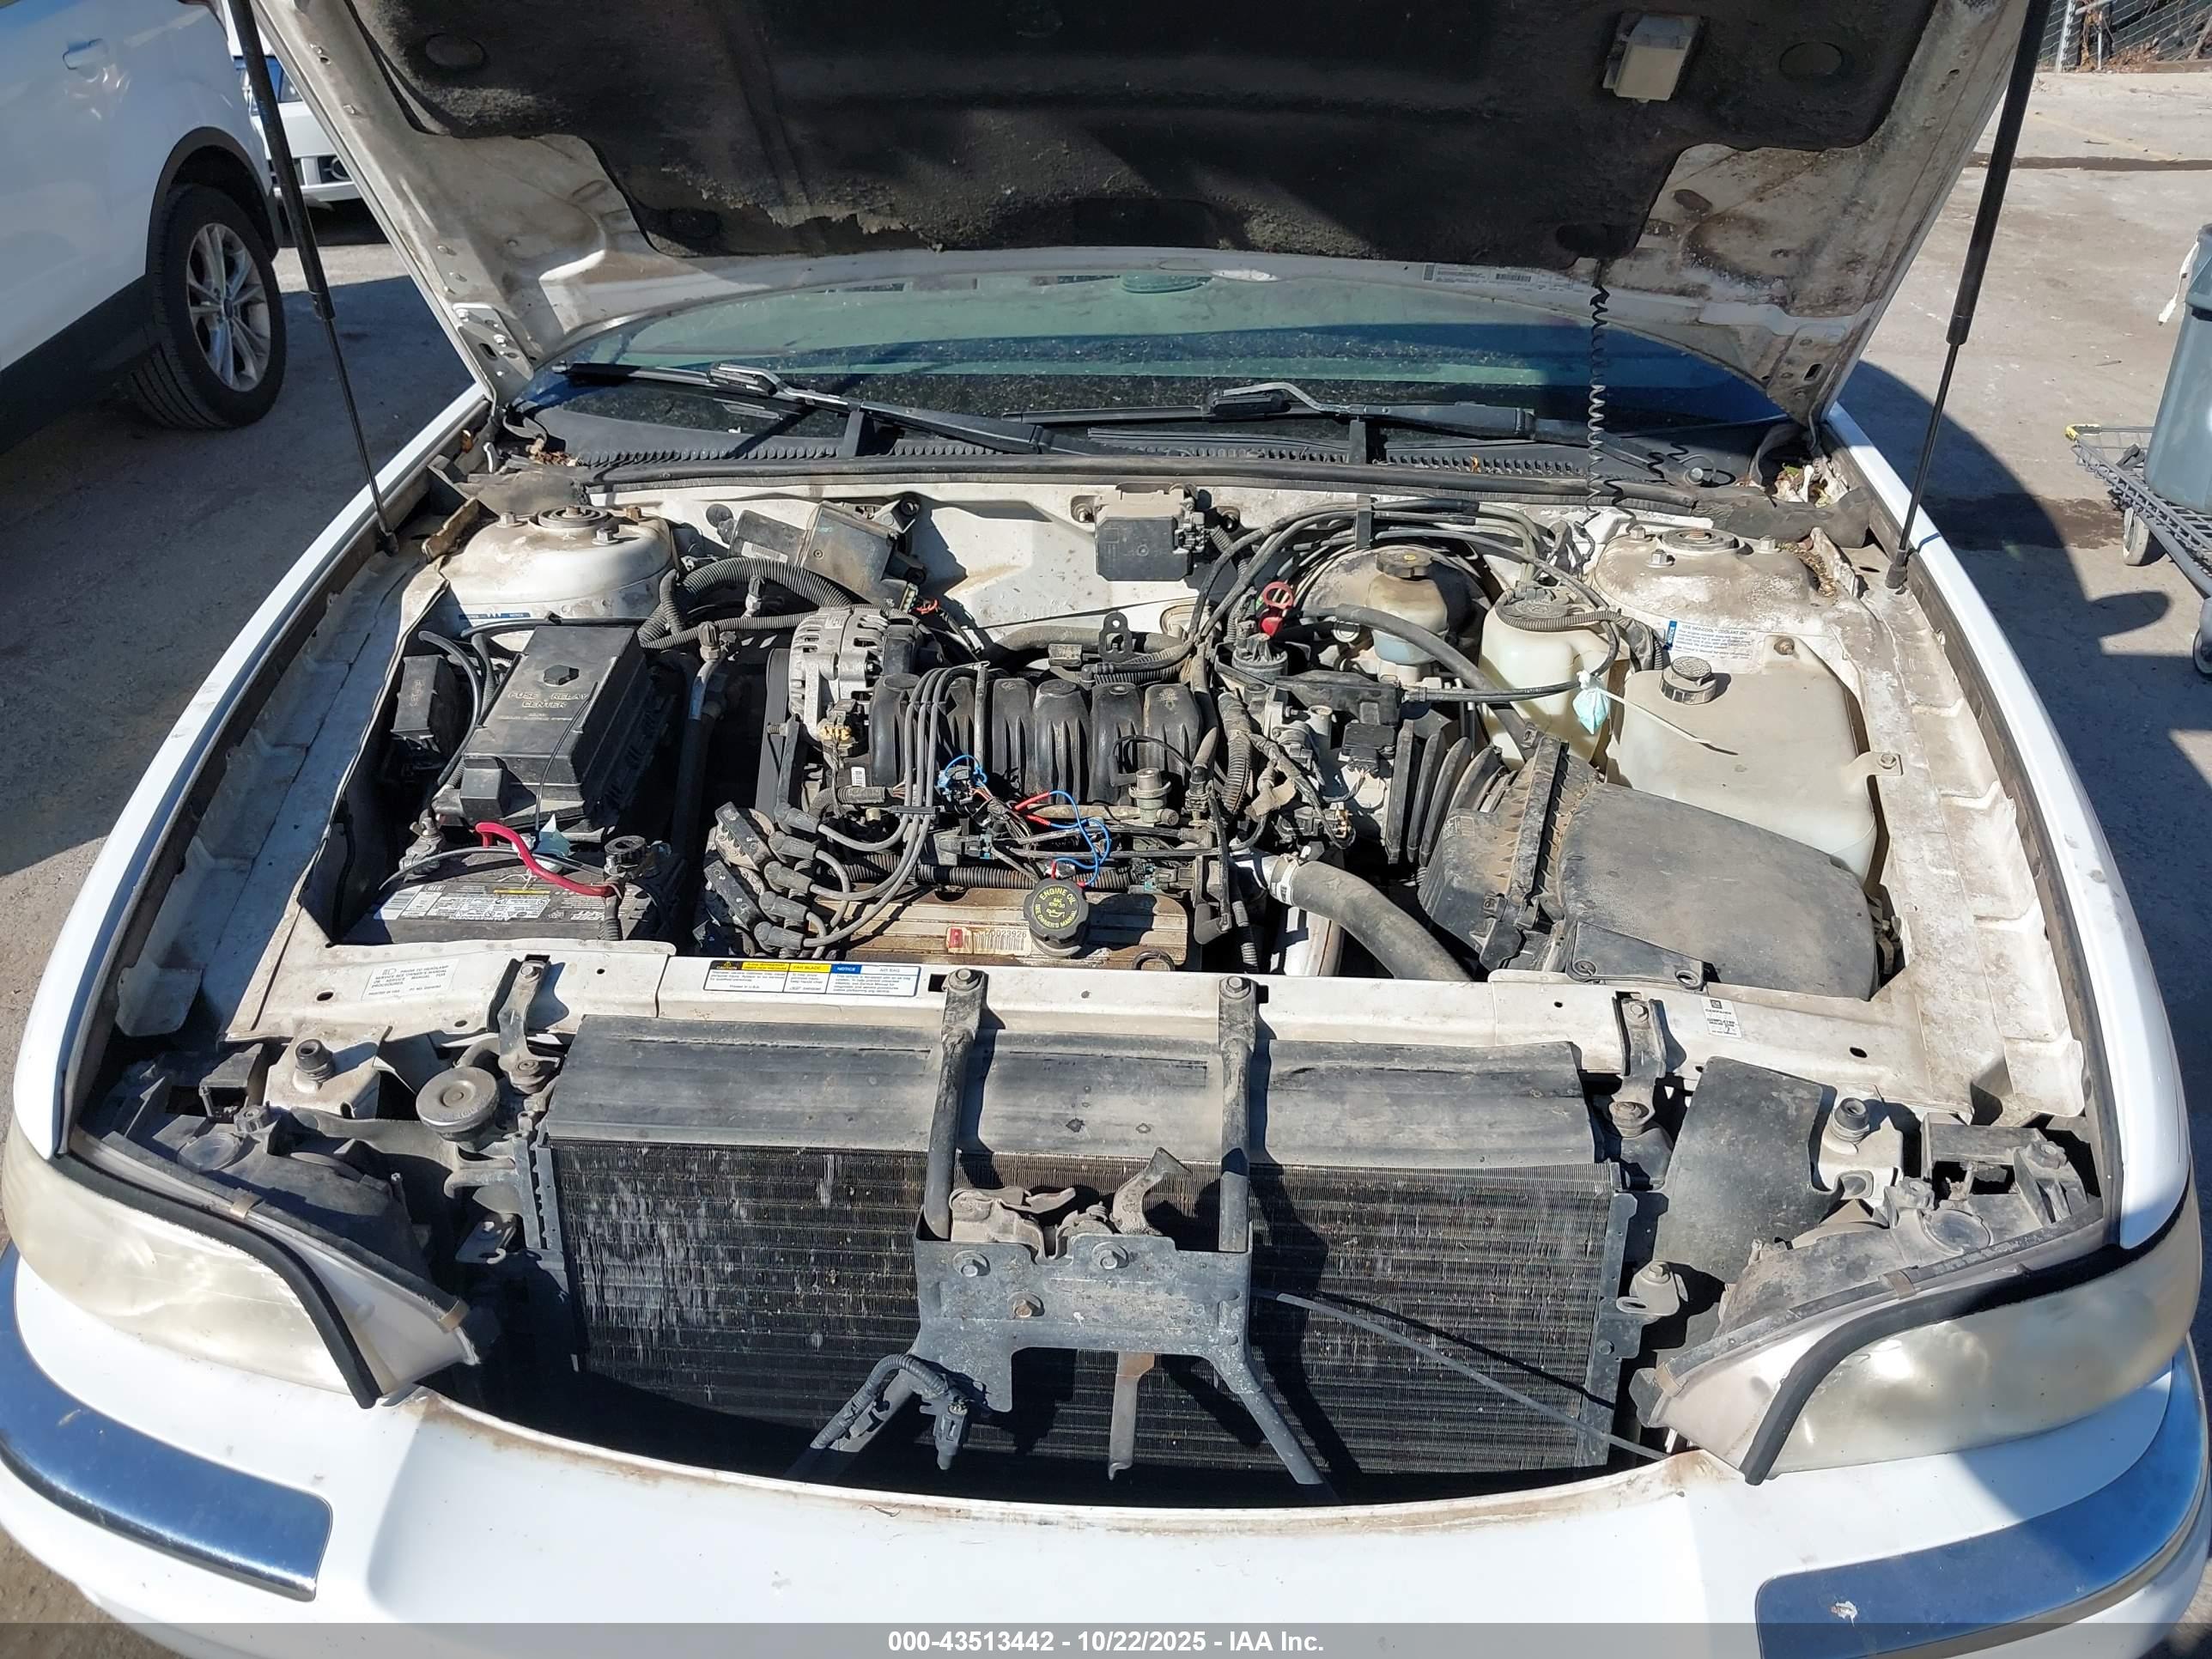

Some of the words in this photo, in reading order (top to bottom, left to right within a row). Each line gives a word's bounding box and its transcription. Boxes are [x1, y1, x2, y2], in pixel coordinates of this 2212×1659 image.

[550, 692, 588, 701] RELAY
[1039, 887, 1068, 901] ENGINE
[1066, 893, 1077, 906] OIL
[1060, 909, 1078, 927] MANUAL
